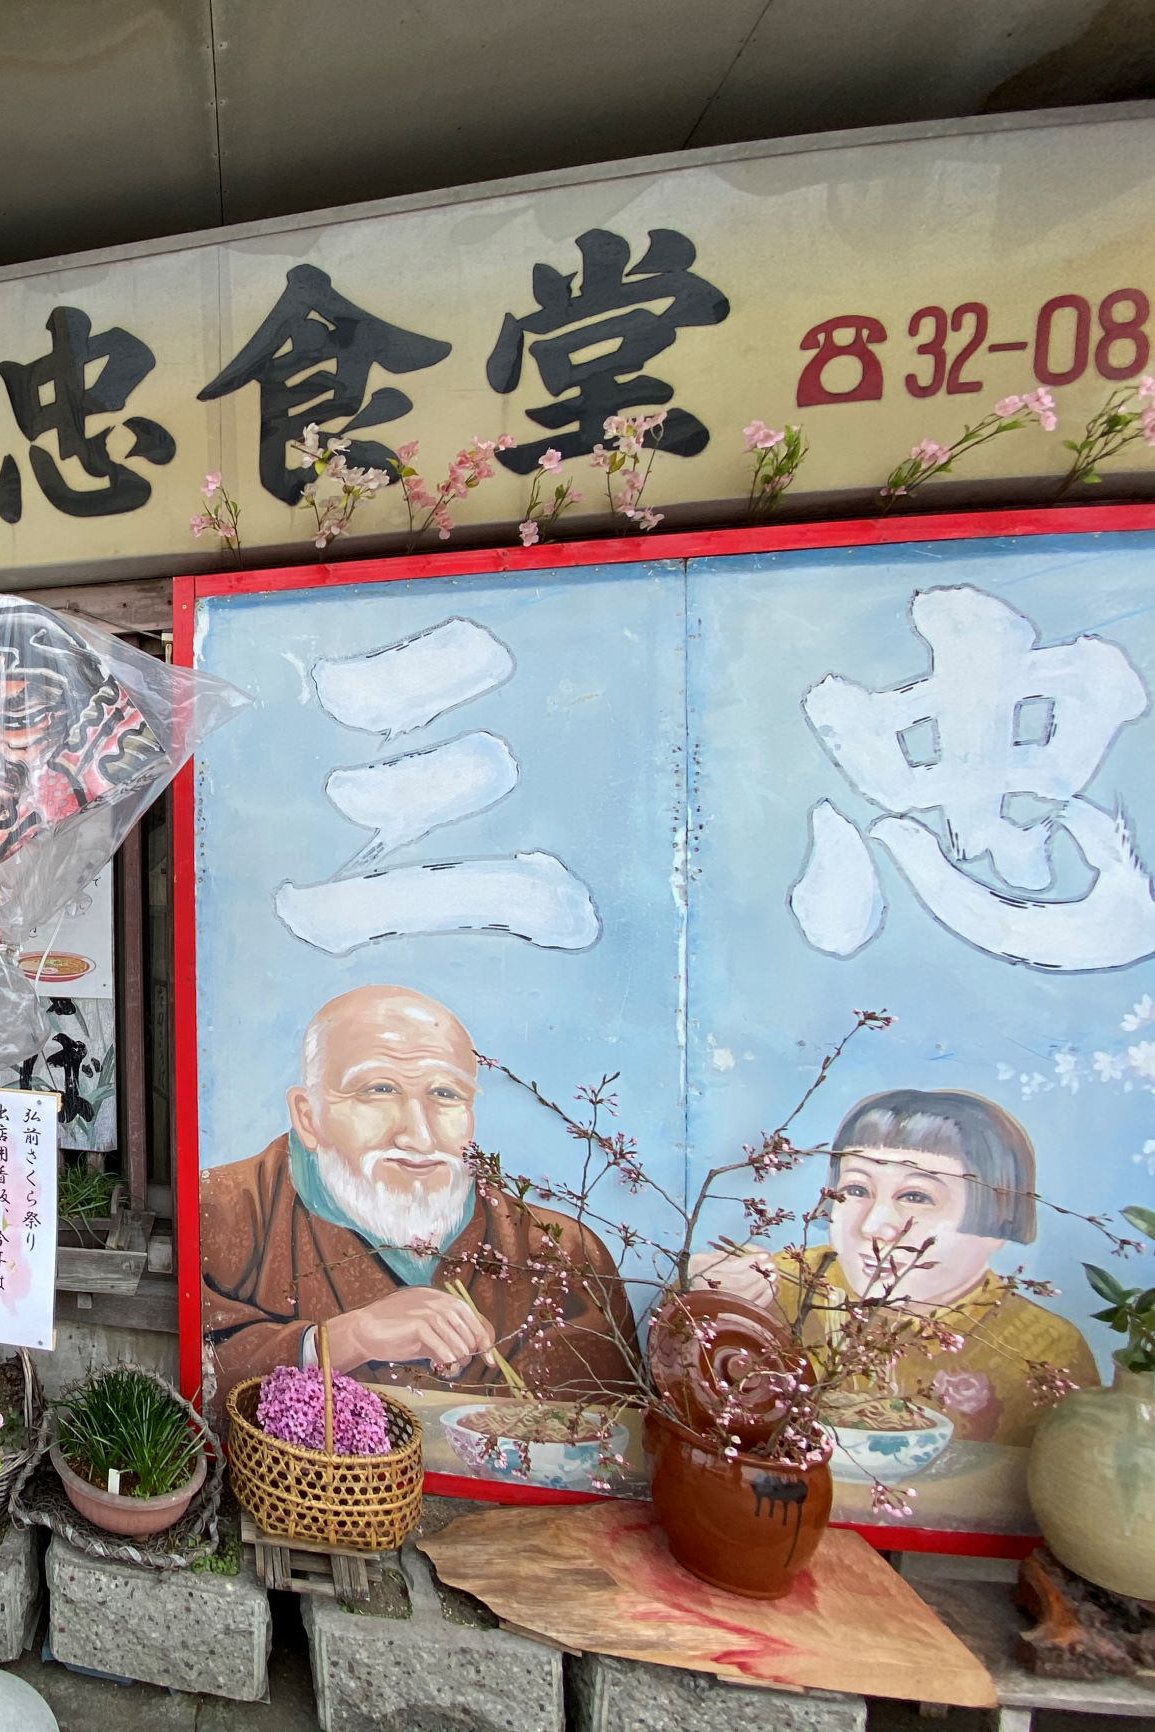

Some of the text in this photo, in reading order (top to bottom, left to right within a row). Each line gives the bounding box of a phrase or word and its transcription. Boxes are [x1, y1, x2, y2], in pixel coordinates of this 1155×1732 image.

[903, 287, 1151, 399] 32-08
[22, 1108, 42, 1253] 弘前さくら祭り
